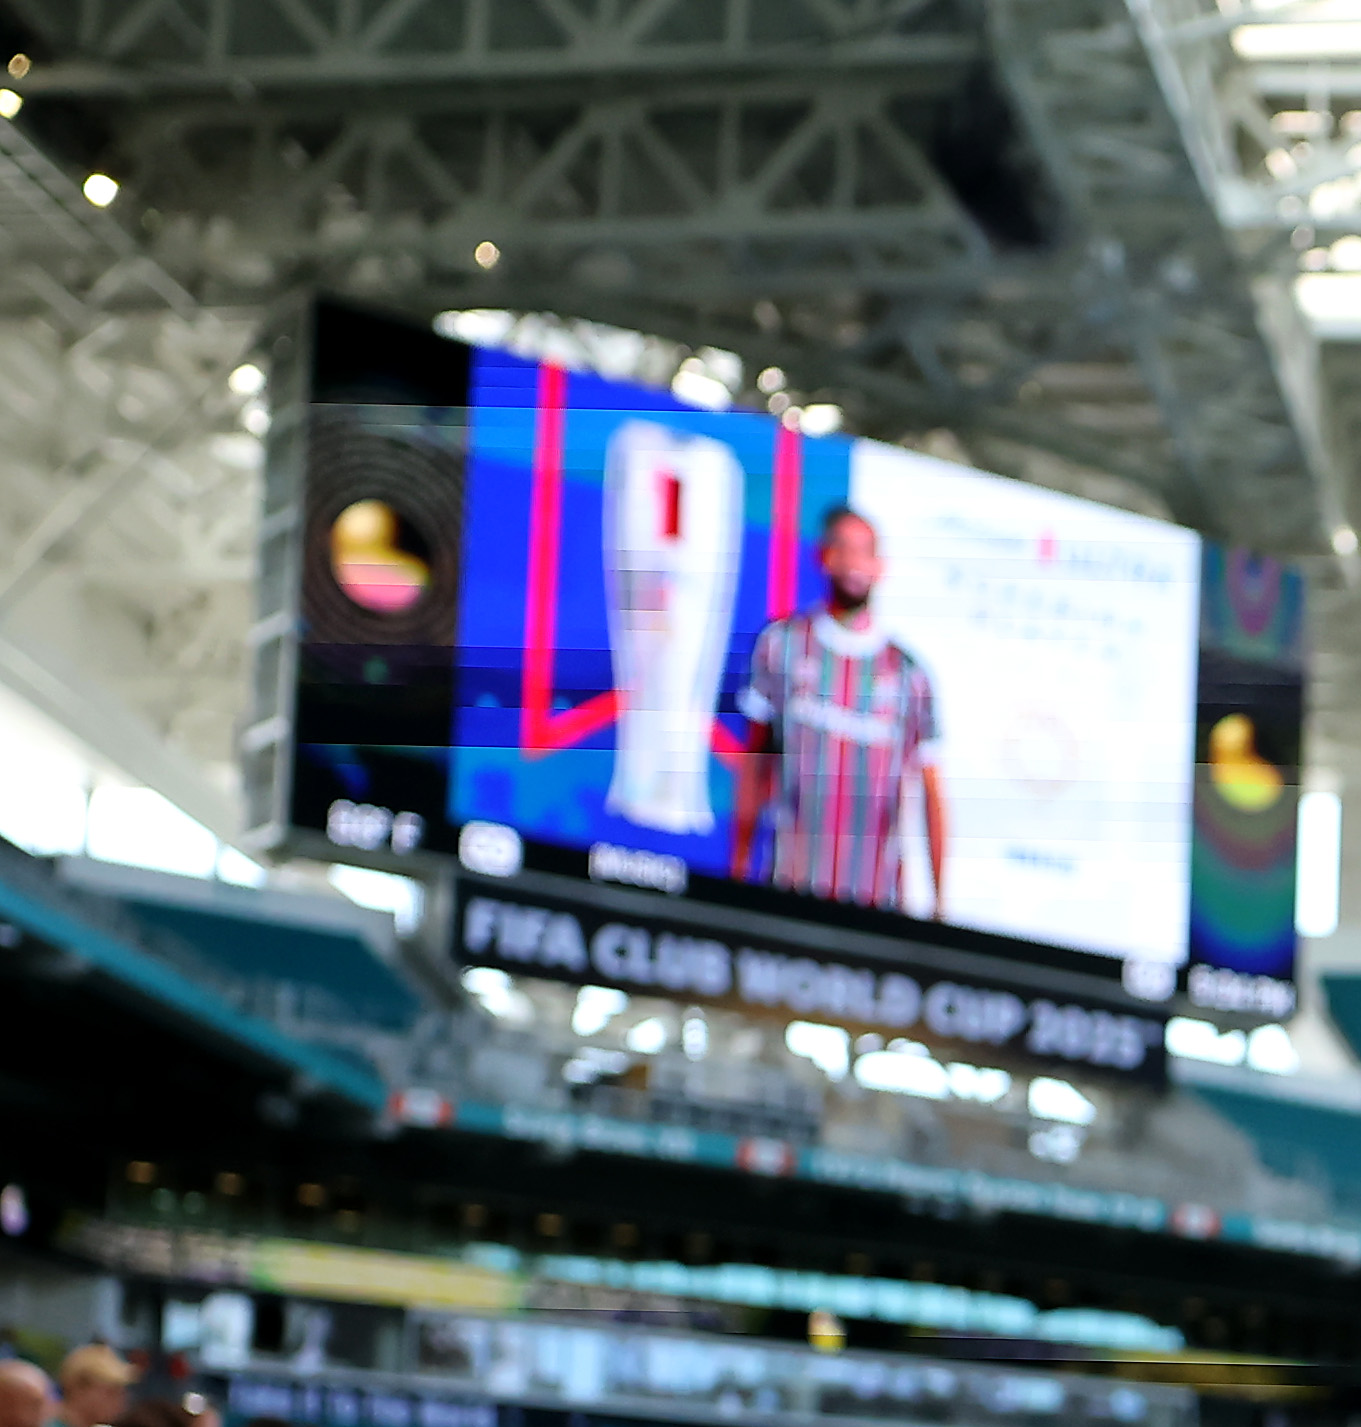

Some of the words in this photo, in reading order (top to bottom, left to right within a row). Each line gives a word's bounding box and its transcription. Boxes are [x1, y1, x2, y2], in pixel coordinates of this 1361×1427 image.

[463, 898, 587, 971] FIFA
[591, 922, 733, 997] CLUB
[736, 947, 921, 1028] WORLD
[924, 979, 1028, 1043] CUP
